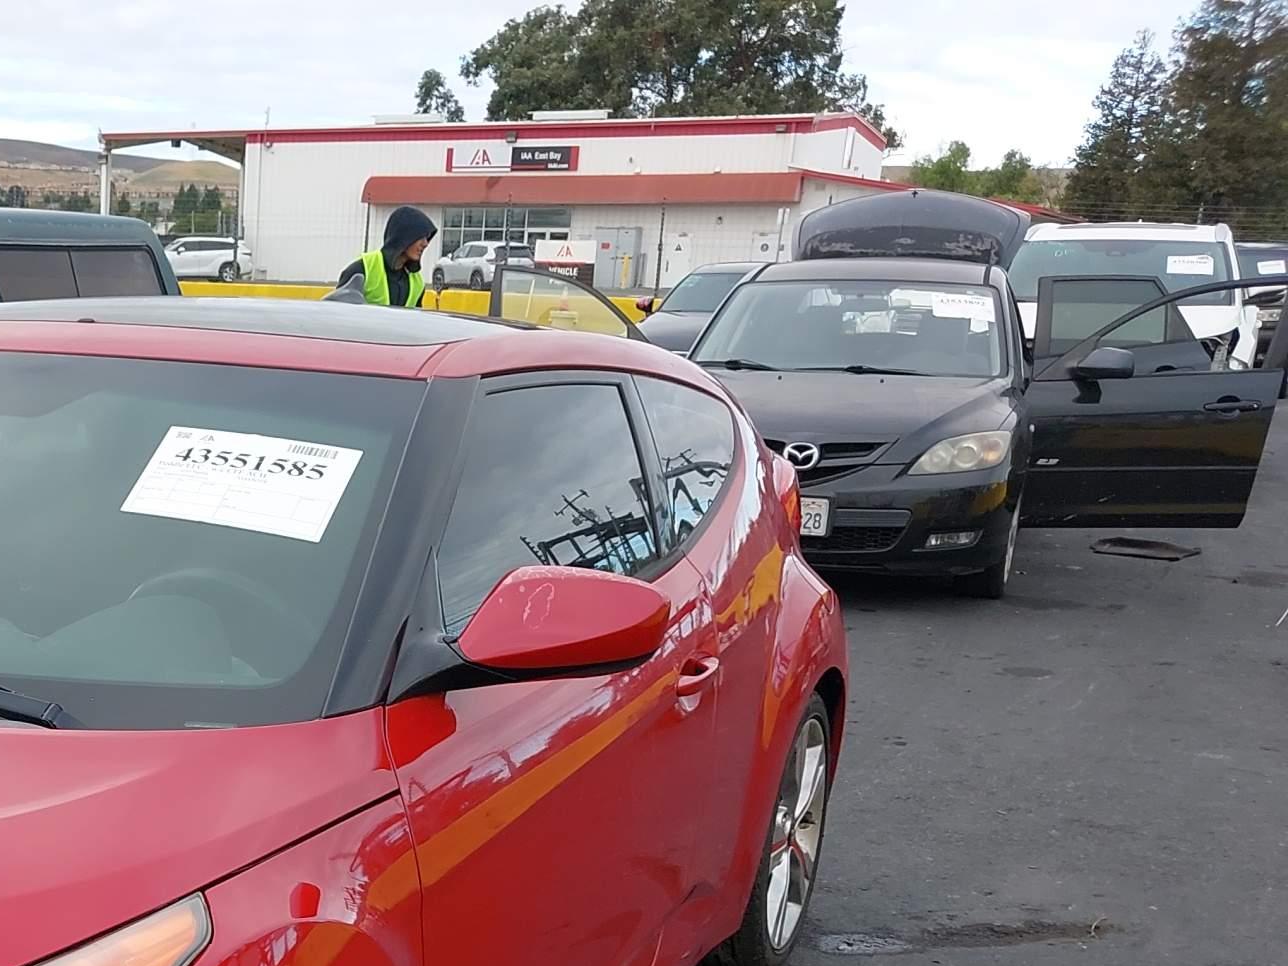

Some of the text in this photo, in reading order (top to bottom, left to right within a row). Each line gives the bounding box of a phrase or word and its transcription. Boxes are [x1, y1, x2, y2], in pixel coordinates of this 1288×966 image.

[520, 151, 562, 161] IAA East Bay
[175, 447, 327, 480] 43551585
